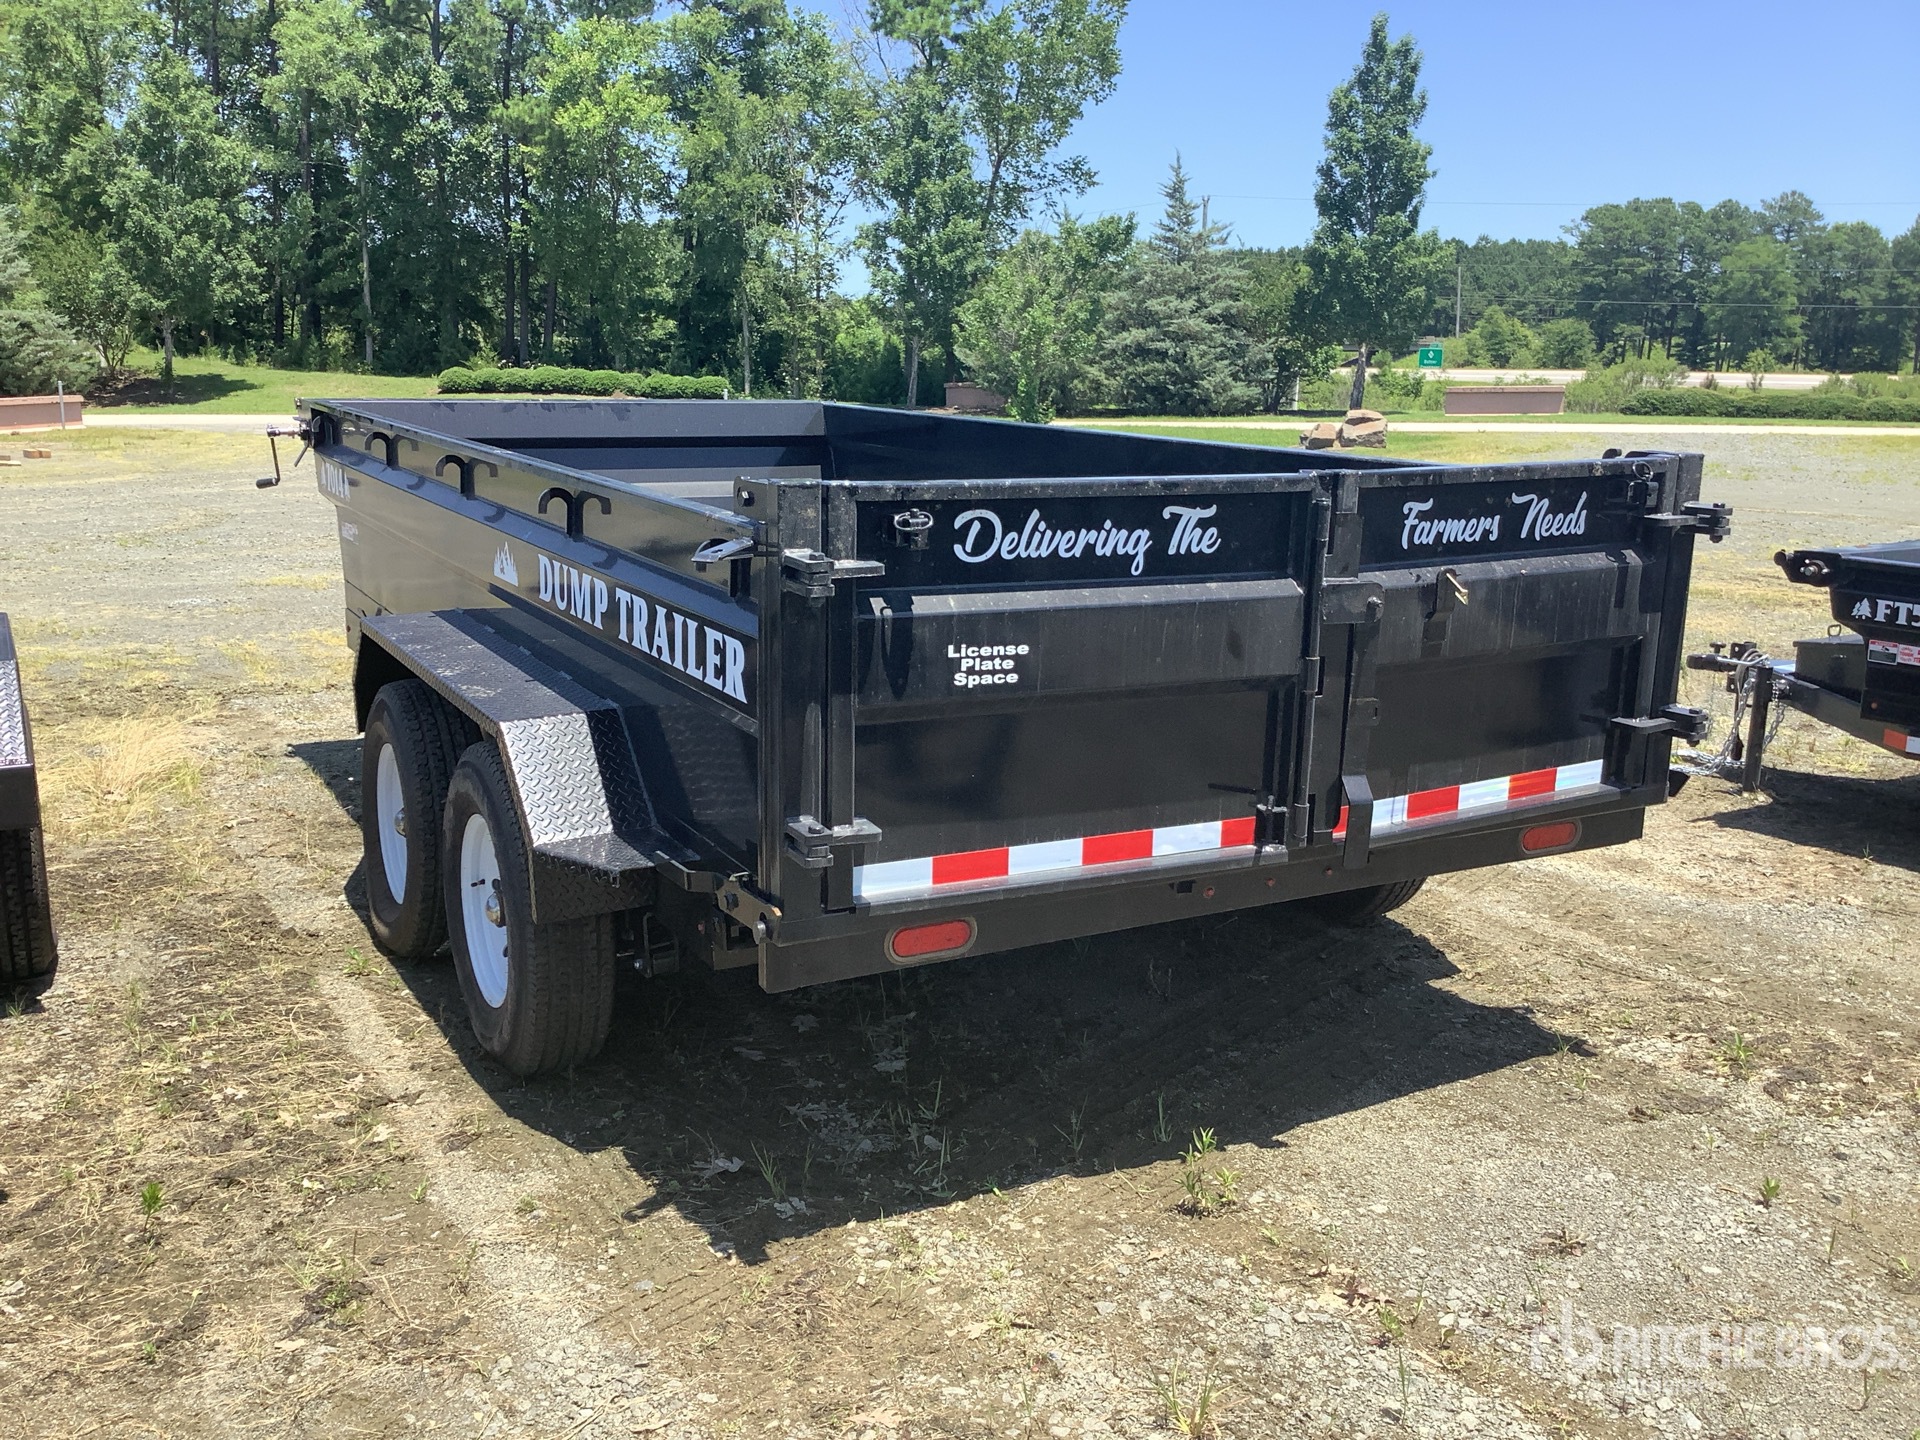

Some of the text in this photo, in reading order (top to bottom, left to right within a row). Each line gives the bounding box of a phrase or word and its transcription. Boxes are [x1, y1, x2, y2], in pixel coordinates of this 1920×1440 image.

[1401, 491, 1587, 550] Farmers Needs
[953, 504, 1221, 576] Delivering The
[537, 553, 748, 704] DUMP TRAILER
[947, 643, 1030, 658] License
[960, 657, 1015, 671] Plate
[953, 672, 1019, 688] Space
